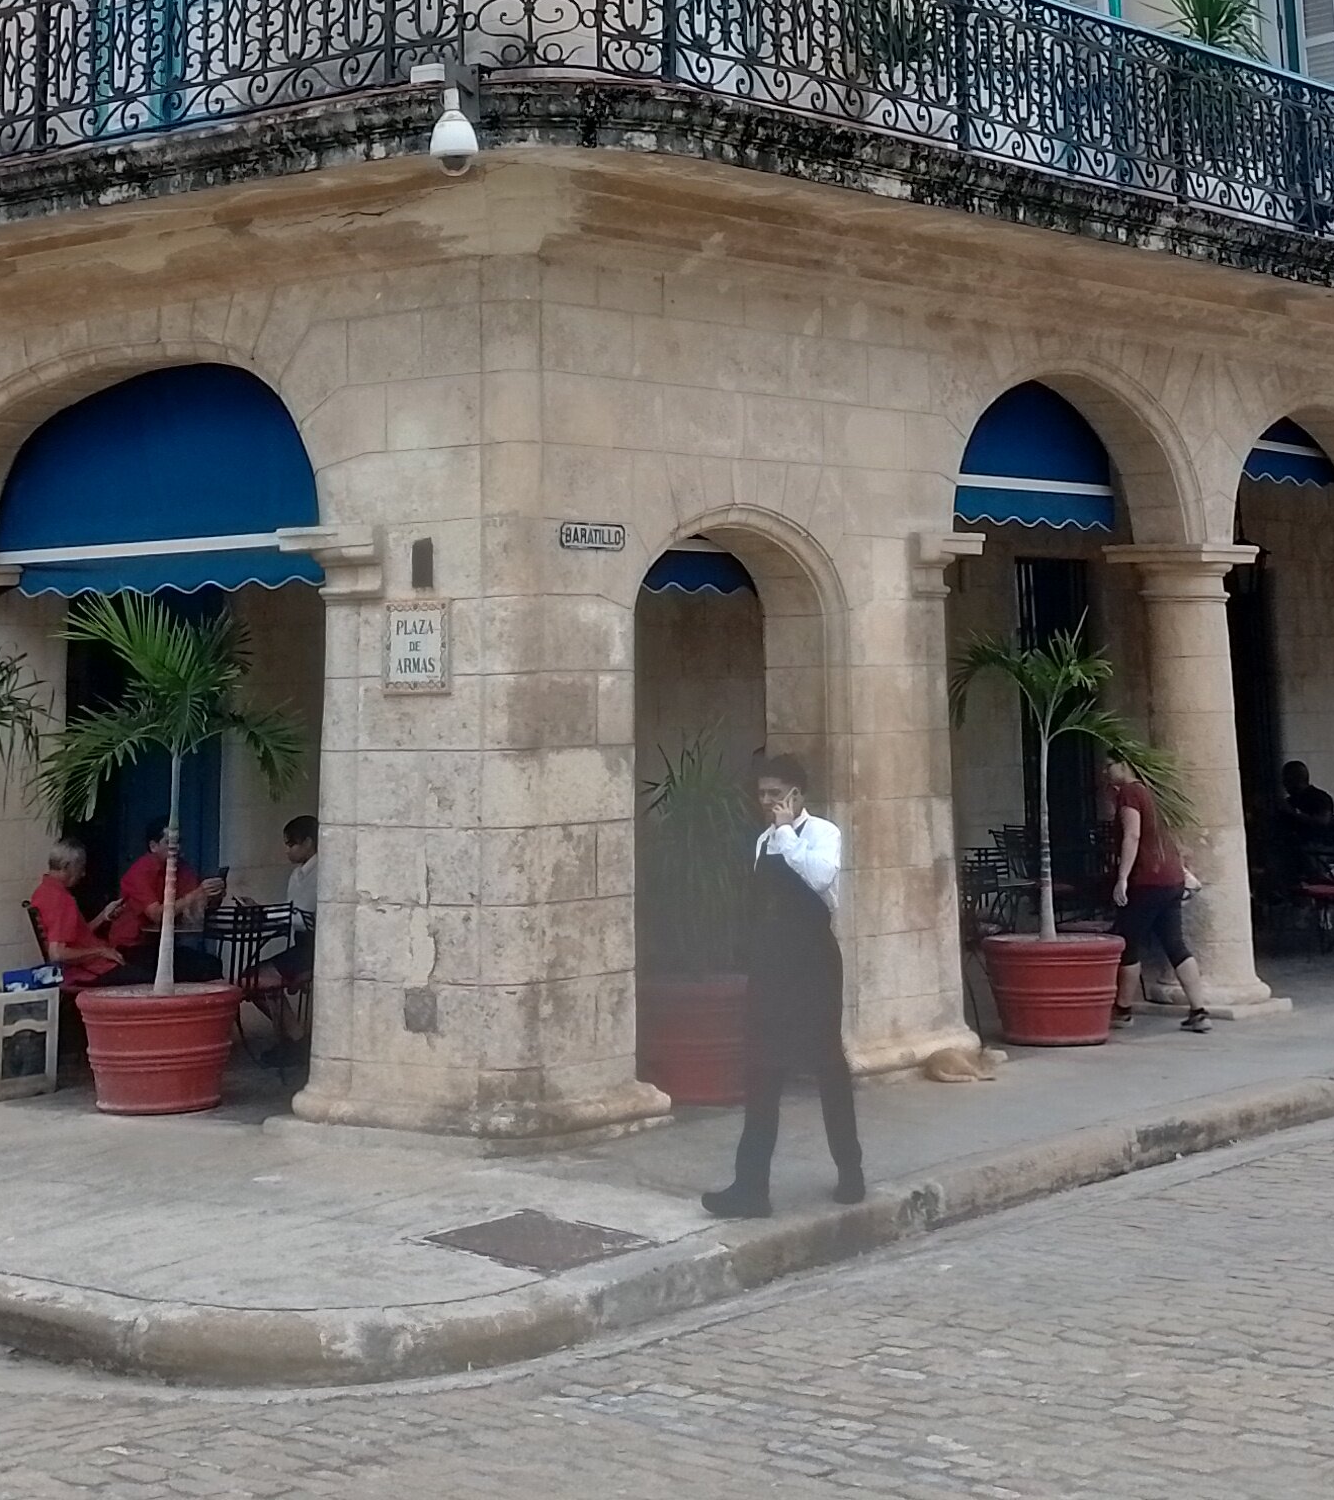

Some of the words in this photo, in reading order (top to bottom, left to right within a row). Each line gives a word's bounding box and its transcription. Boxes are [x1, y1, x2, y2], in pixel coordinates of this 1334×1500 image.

[565, 526, 621, 545] BARATILLO
[396, 619, 434, 635] PLAZA
[408, 640, 422, 652] DE
[396, 656, 436, 674] ARMAS
